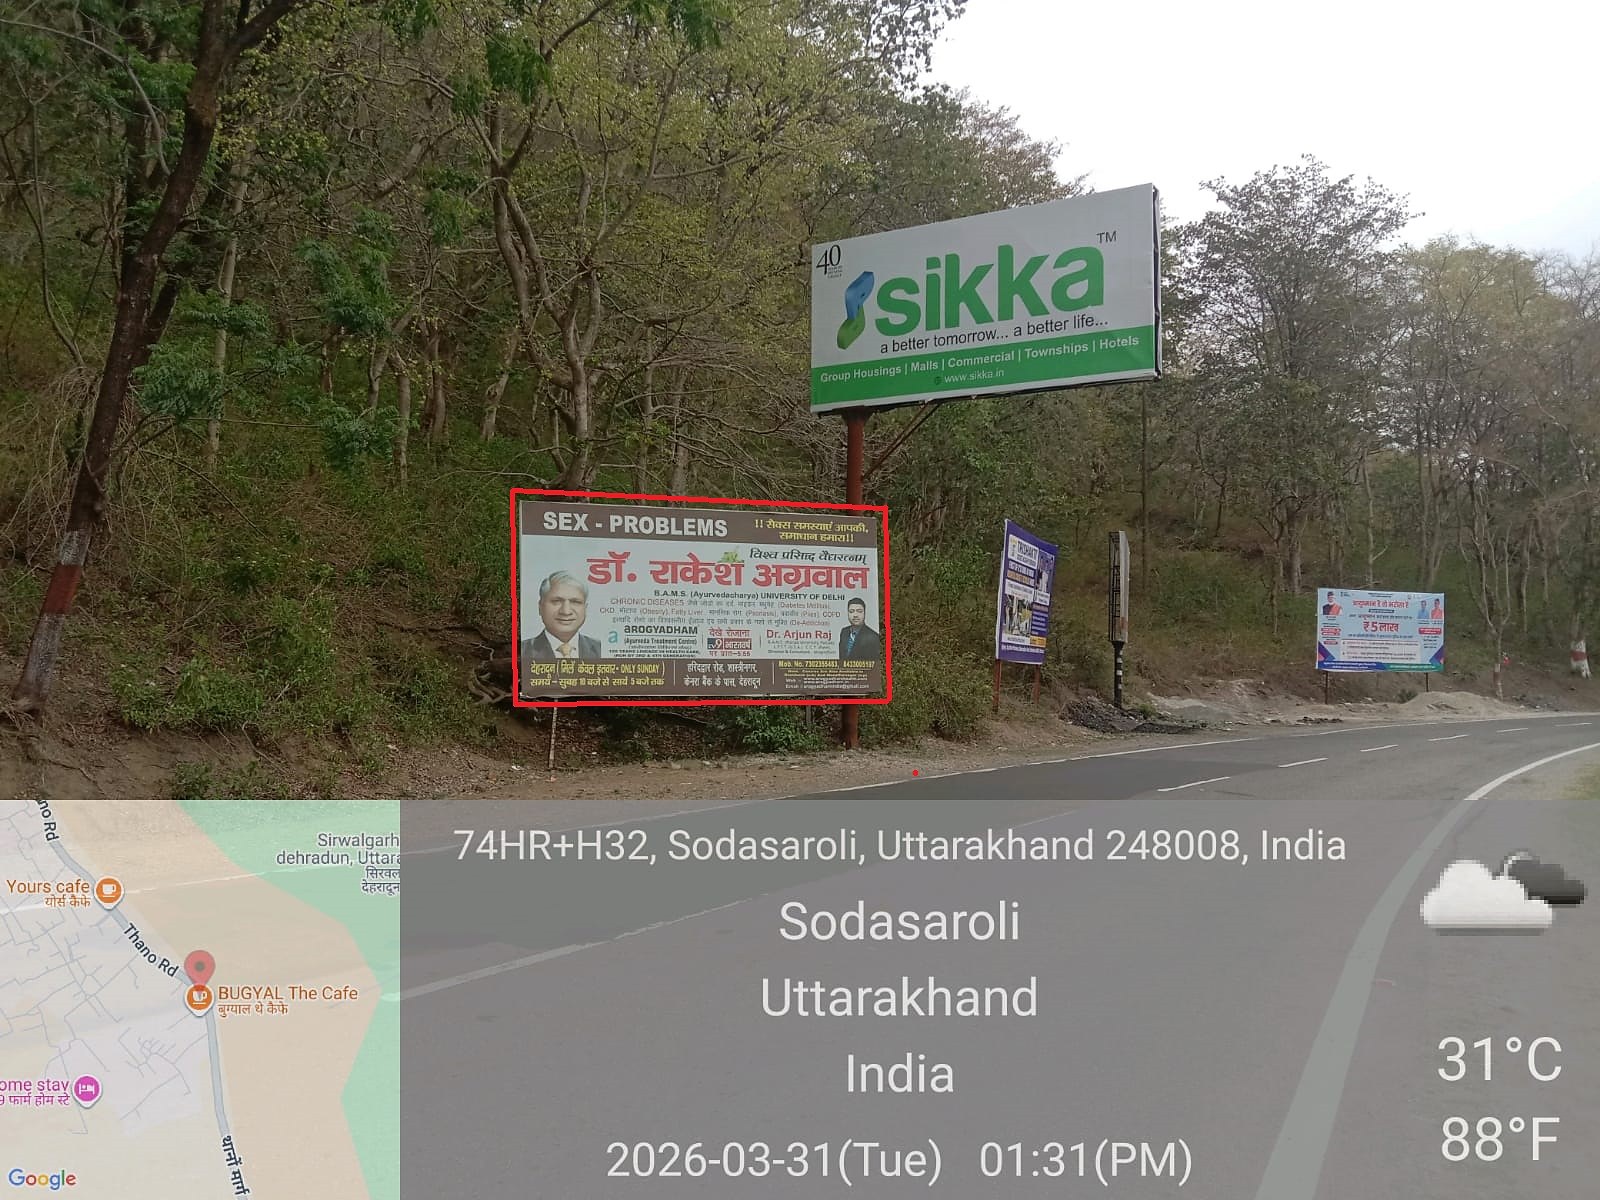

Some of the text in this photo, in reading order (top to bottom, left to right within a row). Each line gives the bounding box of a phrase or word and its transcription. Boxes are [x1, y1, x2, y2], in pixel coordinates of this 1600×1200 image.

[1096, 231, 1117, 244] TM
[816, 245, 841, 275] 40
[875, 244, 1105, 337] sikka
[880, 313, 1108, 354] a better tomorrow... a better life...
[820, 336, 1140, 385] Group Housings Malls Commercial Townships Hotels
[944, 367, 1005, 384] www.sikka.in
[543, 511, 589, 532] SEX
[609, 514, 728, 538] PROBLEMS
[766, 519, 791, 530] सेक्स
[779, 531, 817, 541] समाधान
[750, 548, 778, 559] विश्व
[586, 551, 870, 592] डॉ. राकेश अग्रवाल
[647, 598, 684, 606] DISEASES
[690, 591, 758, 600] (Ayurvedacharya)
[760, 592, 807, 600] UNIVERSITY
[1371, 621, 1378, 632] 5
[766, 630, 832, 640] Dr. Arjun Raj
[577, 660, 595, 675] केवल
[620, 663, 635, 673] ONLY
[714, 675, 721, 686] के
[738, 675, 761, 688] देहरादून
